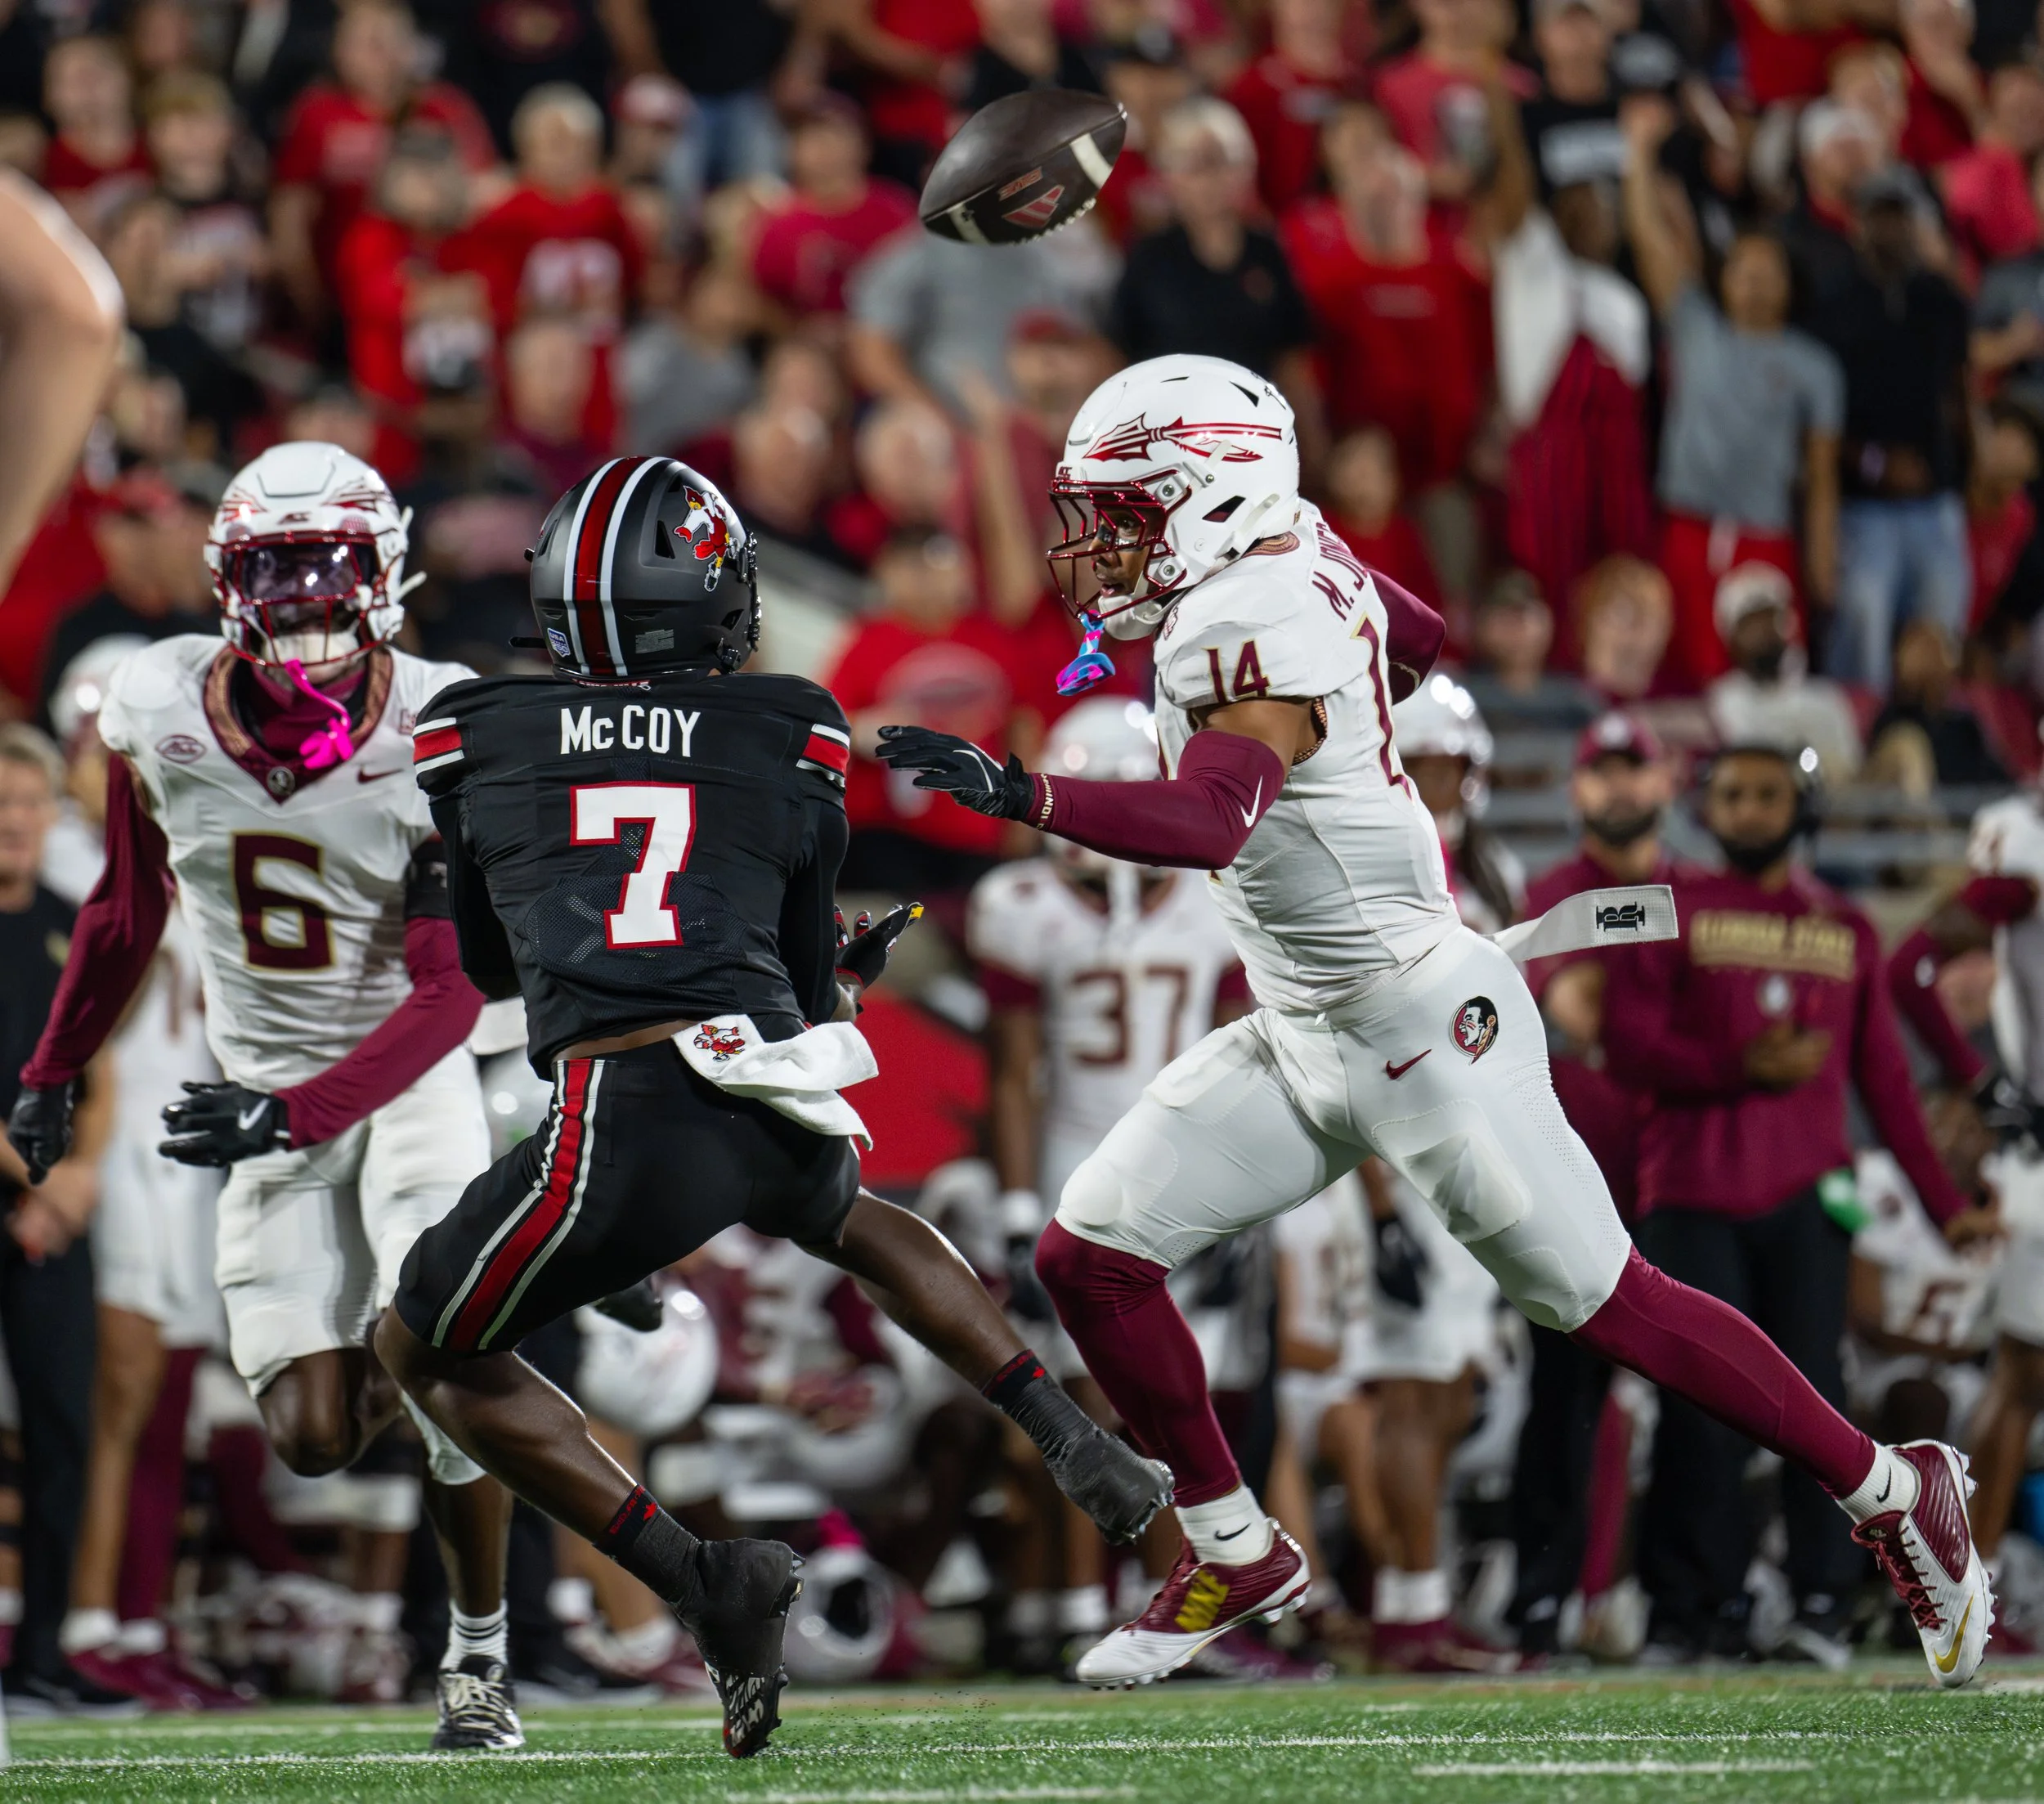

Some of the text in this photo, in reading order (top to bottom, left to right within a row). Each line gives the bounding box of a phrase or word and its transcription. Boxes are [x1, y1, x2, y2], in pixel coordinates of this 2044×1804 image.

[1201, 637, 1272, 705] 14
[230, 830, 338, 974] 6
[569, 780, 697, 949] 7
[1069, 961, 1192, 1066] 37
